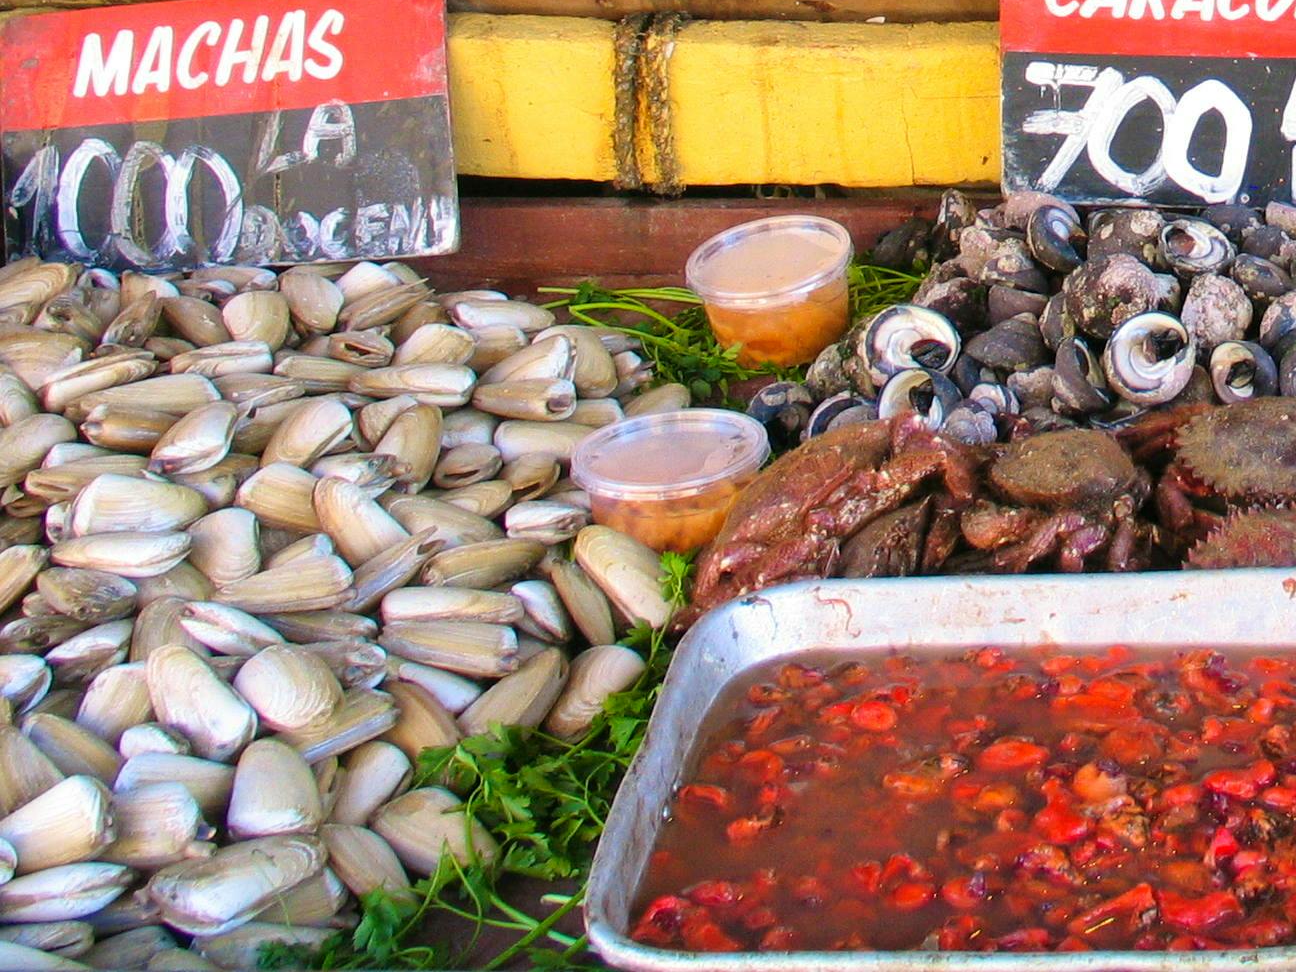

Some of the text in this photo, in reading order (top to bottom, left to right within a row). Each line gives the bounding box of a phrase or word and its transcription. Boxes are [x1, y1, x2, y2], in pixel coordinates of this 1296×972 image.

[73, 9, 345, 98] MACHAS
[257, 99, 357, 168] LA
[1022, 64, 1253, 204] 700
